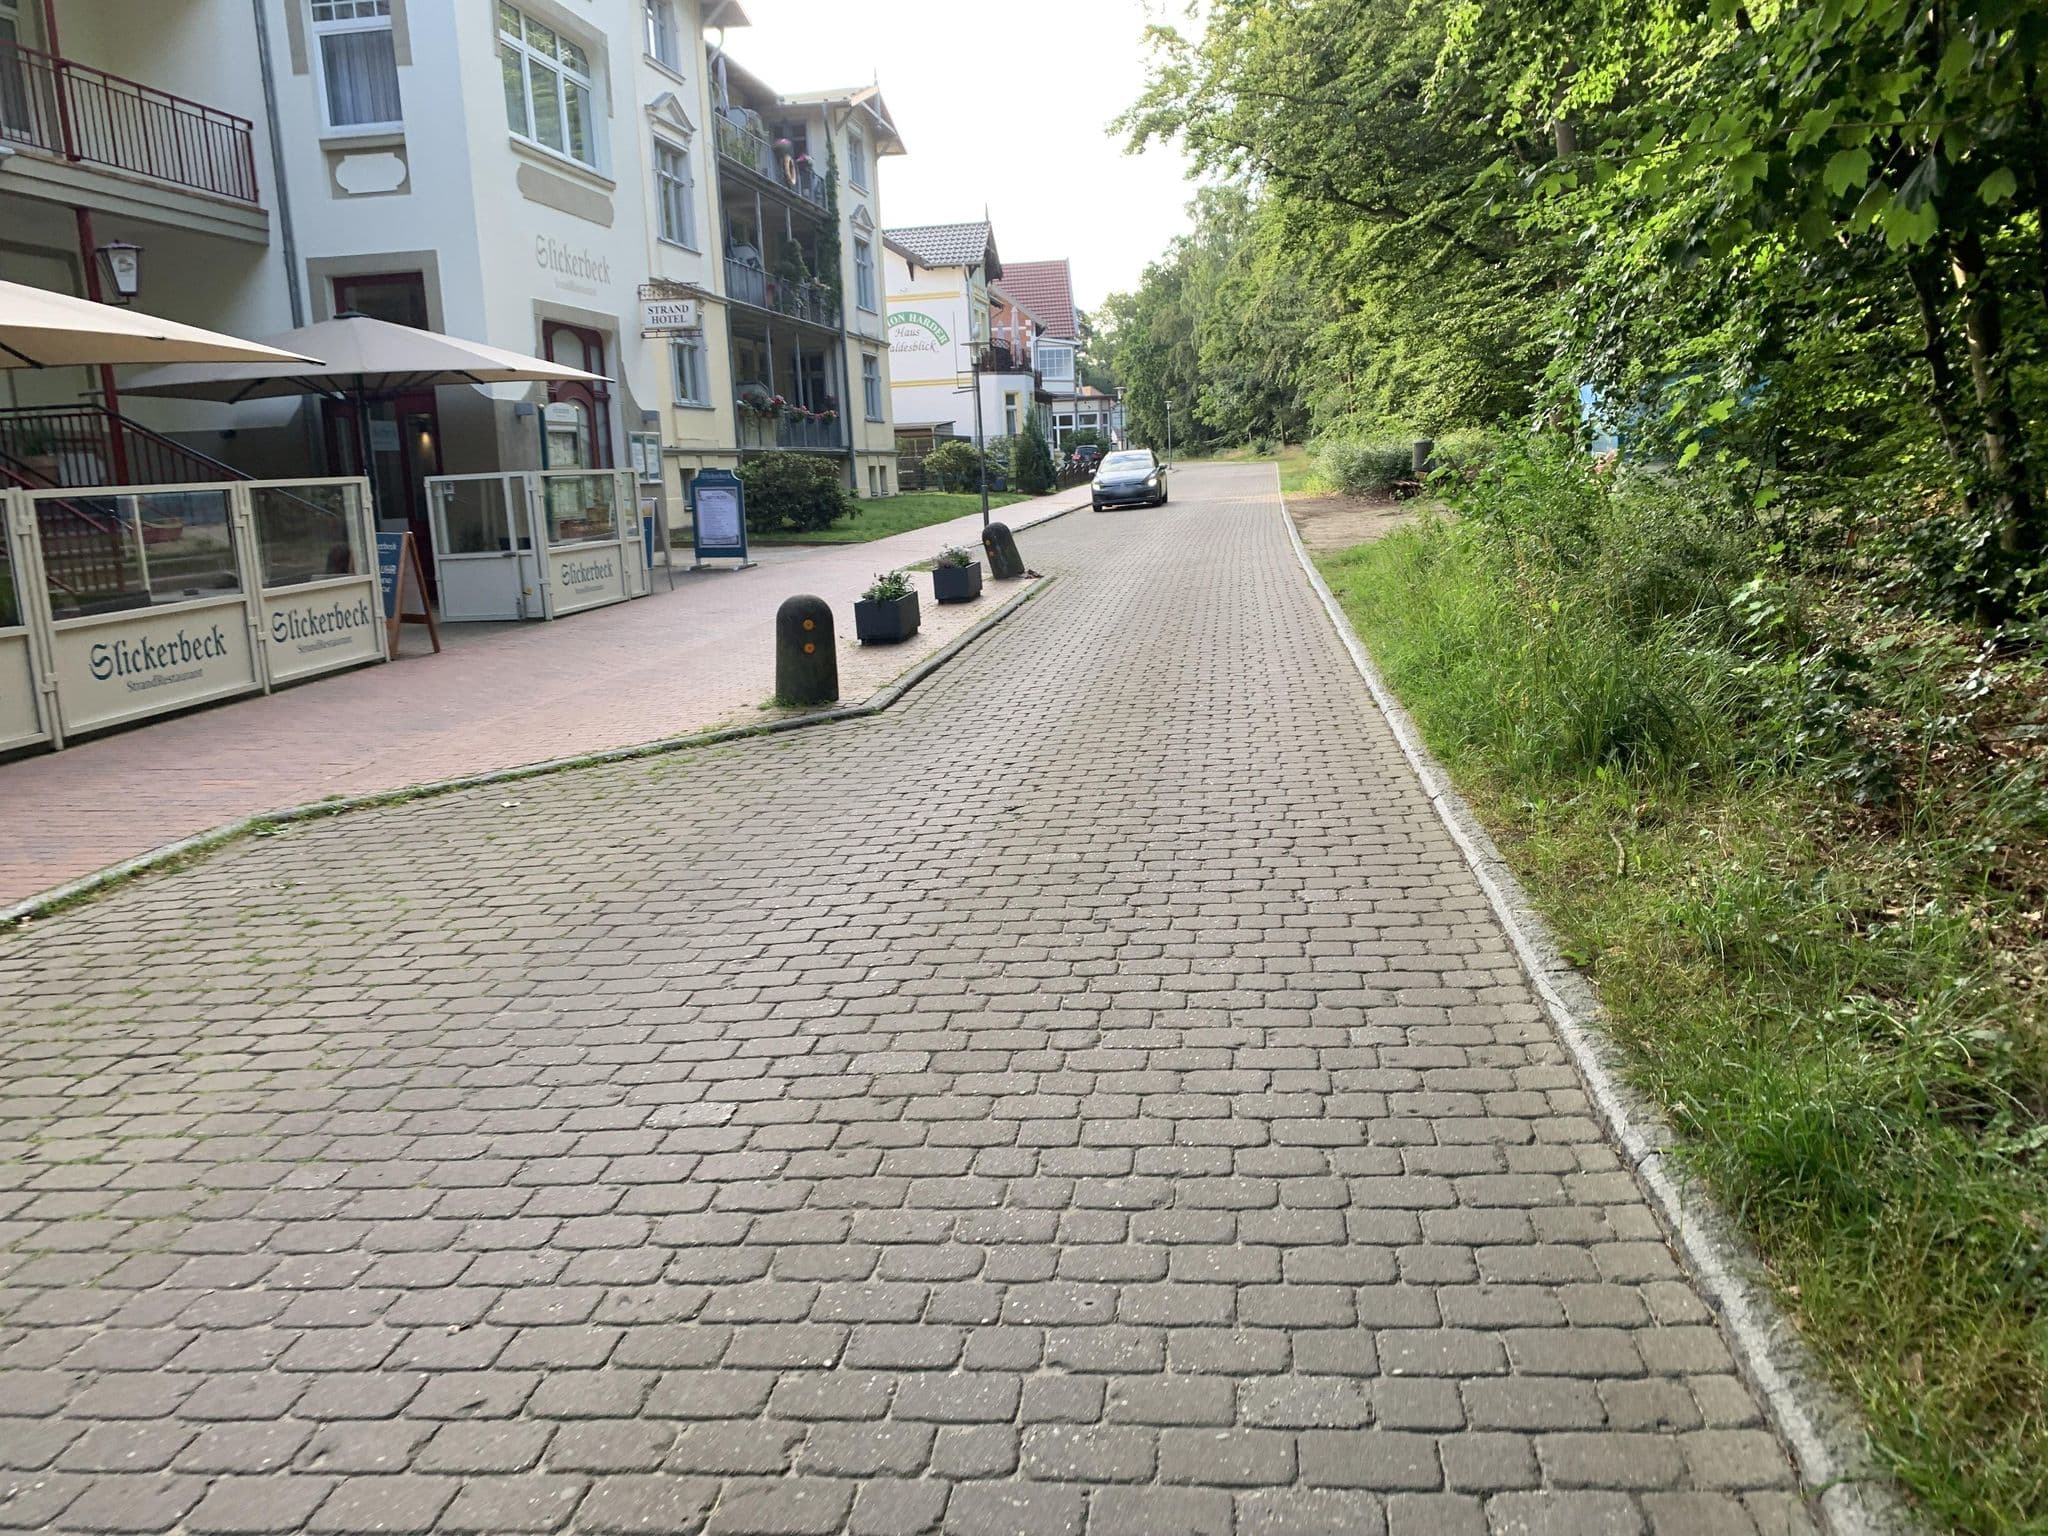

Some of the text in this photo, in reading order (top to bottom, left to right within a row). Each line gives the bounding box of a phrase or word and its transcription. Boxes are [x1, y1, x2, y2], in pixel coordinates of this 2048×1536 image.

[535, 234, 612, 286] Slickerbeck
[647, 304, 689, 315] STRAND
[651, 314, 687, 324] HOTEL
[894, 326, 920, 338] Haus
[909, 312, 948, 345] HARDER
[889, 340, 938, 353] aldesblick
[271, 598, 370, 643] Slickerbeck
[89, 624, 227, 681] Slickerbeck
